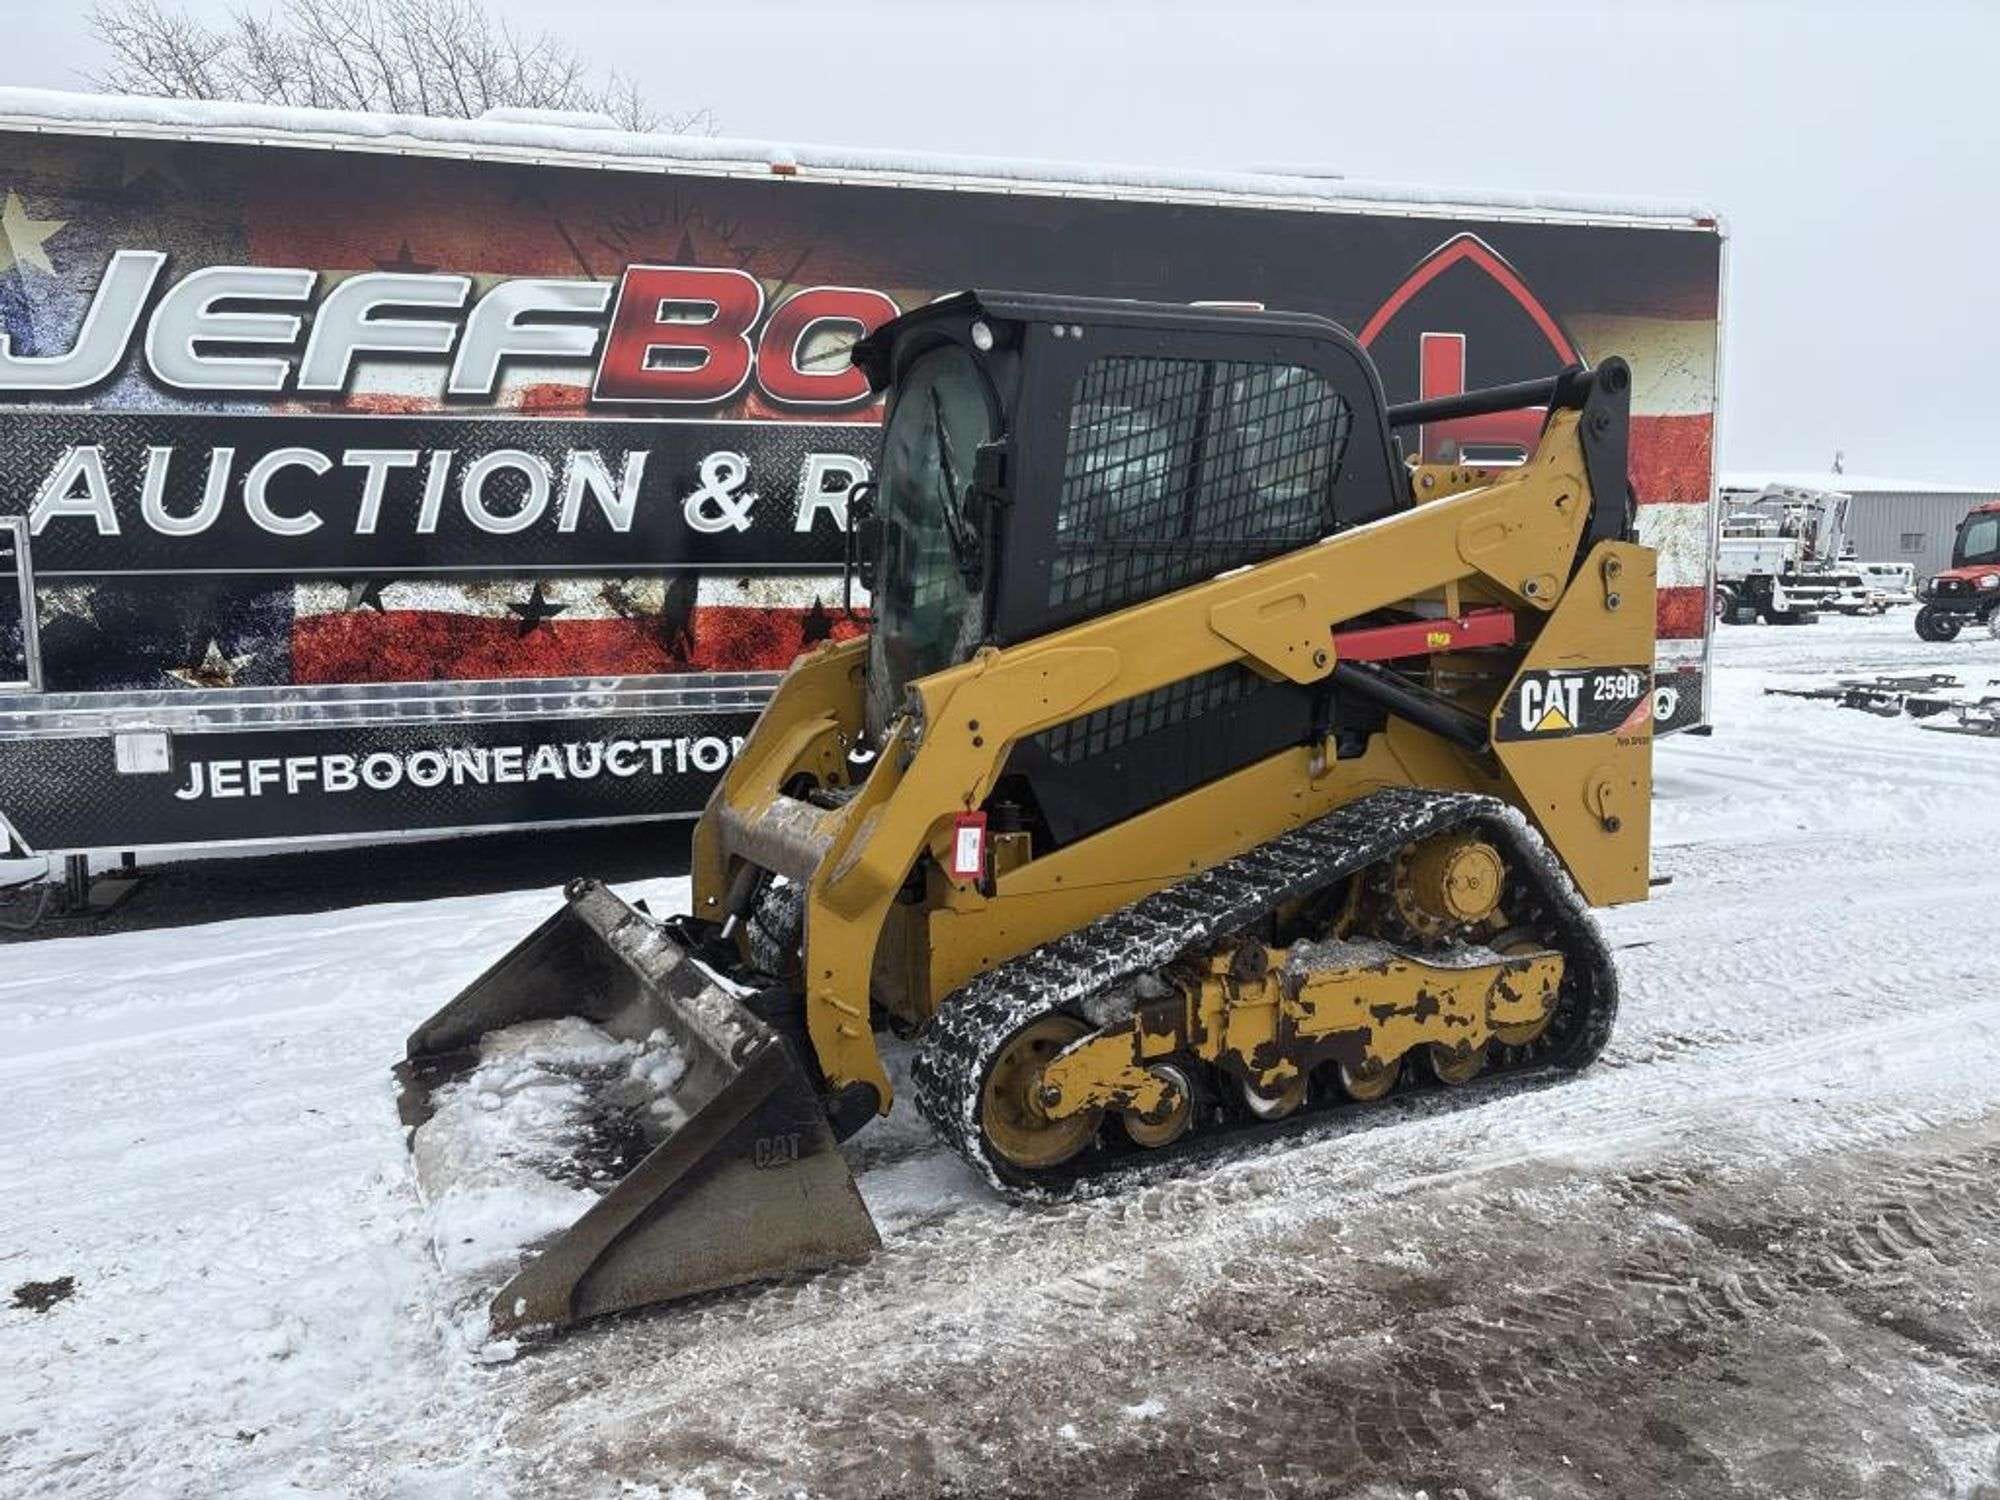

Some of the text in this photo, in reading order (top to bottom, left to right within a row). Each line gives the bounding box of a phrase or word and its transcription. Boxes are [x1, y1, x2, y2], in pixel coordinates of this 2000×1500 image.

[0, 250, 903, 405] JEFFBO
[28, 445, 651, 536] AUCTION
[682, 451, 757, 533] &
[1519, 674, 1640, 732] CAT 259D
[755, 1132, 801, 1170] CAT
